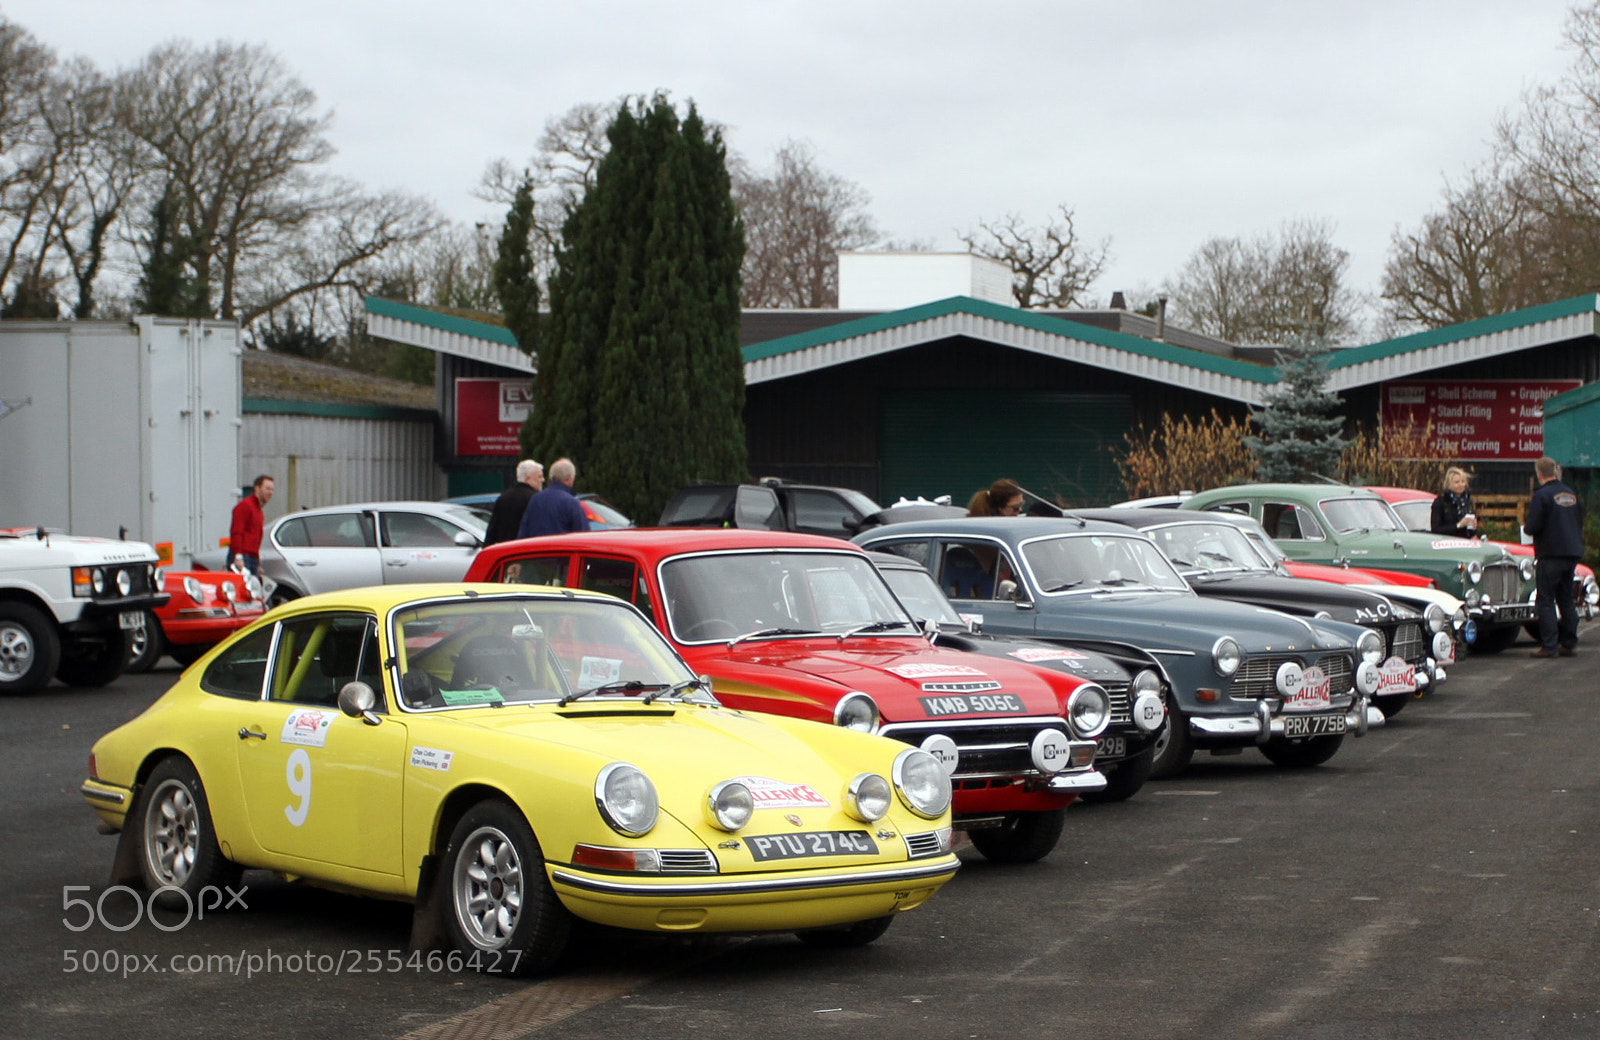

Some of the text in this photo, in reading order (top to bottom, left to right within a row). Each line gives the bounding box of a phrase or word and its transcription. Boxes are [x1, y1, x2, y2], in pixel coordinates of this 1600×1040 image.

[1438, 387, 1460, 399] Shell
[1462, 387, 1497, 399] Scheme
[1437, 405, 1492, 420] Stand Fitting
[1437, 422, 1475, 434] Electrics
[1461, 438, 1500, 454] Covering
[926, 694, 1020, 715] KMB 505C
[1286, 715, 1345, 735] PRX 775B
[284, 748, 312, 827] 9
[752, 831, 869, 858] PTU 274C
[894, 891, 910, 900] TOW
